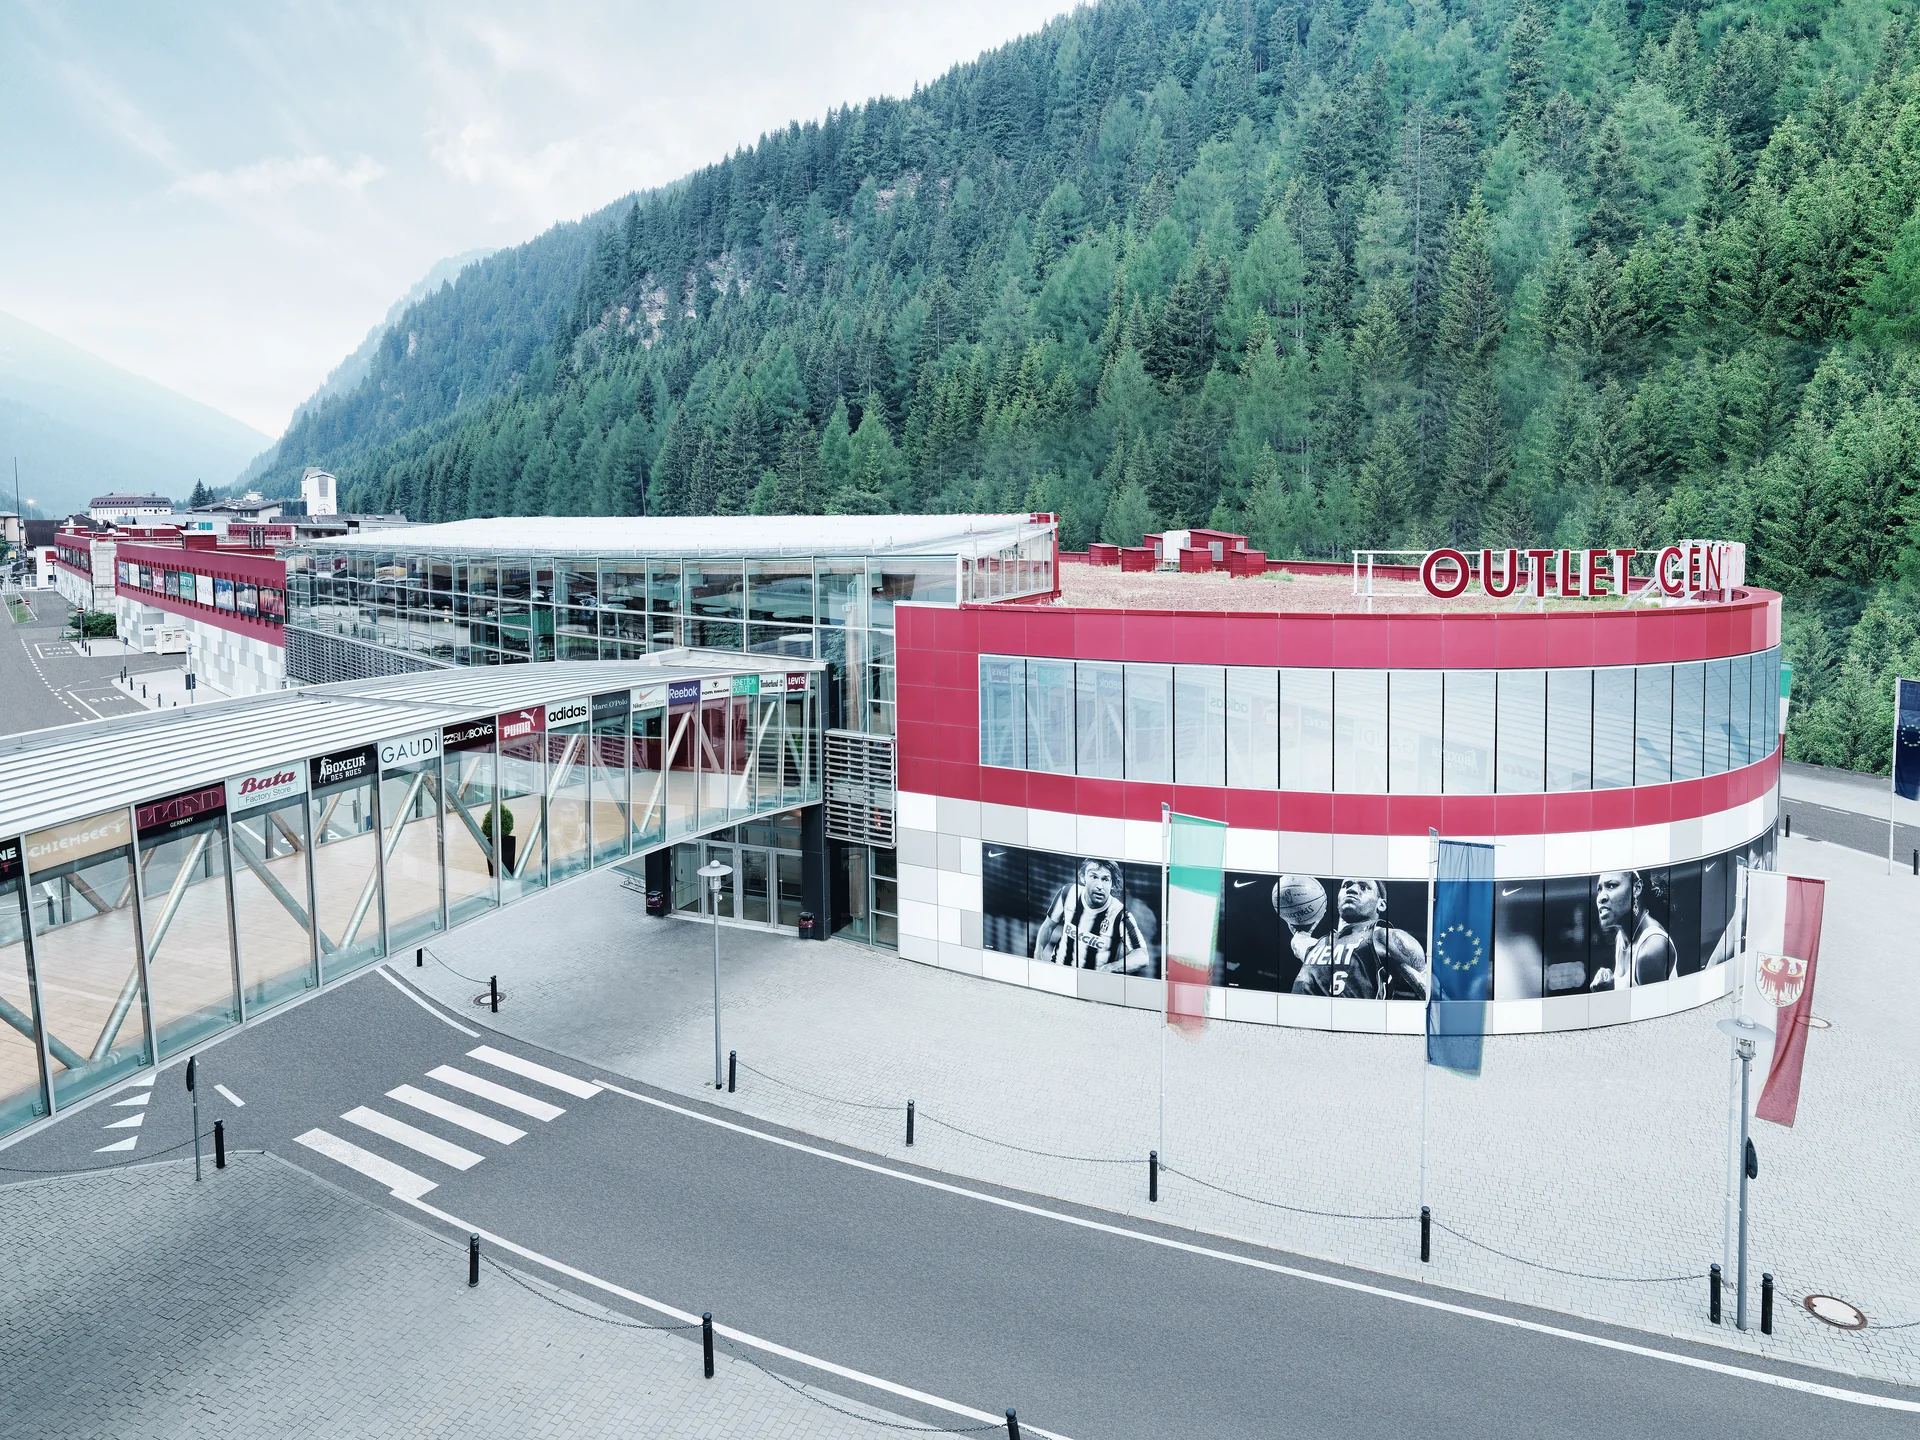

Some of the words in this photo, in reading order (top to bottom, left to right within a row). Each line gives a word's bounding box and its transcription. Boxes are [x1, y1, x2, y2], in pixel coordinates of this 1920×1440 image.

[1420, 547, 1636, 599] OUTLET
[1656, 542, 1745, 595] CEN
[732, 678, 757, 687] BENETTON
[732, 685, 750, 694] OUTLET
[669, 687, 698, 699] Reebok
[548, 705, 587, 722] adidas
[592, 702, 609, 711] Marc
[504, 721, 531, 738] PUMA
[326, 755, 366, 775] BOXEUR
[238, 771, 296, 795] Bata
[330, 772, 344, 782] DES
[345, 768, 362, 778] RUES
[245, 791, 272, 804] Factory
[273, 786, 291, 796] Store
[169, 816, 193, 828] GERMANY
[1305, 937, 1364, 965] HEAT
[1330, 970, 1349, 996] 6
